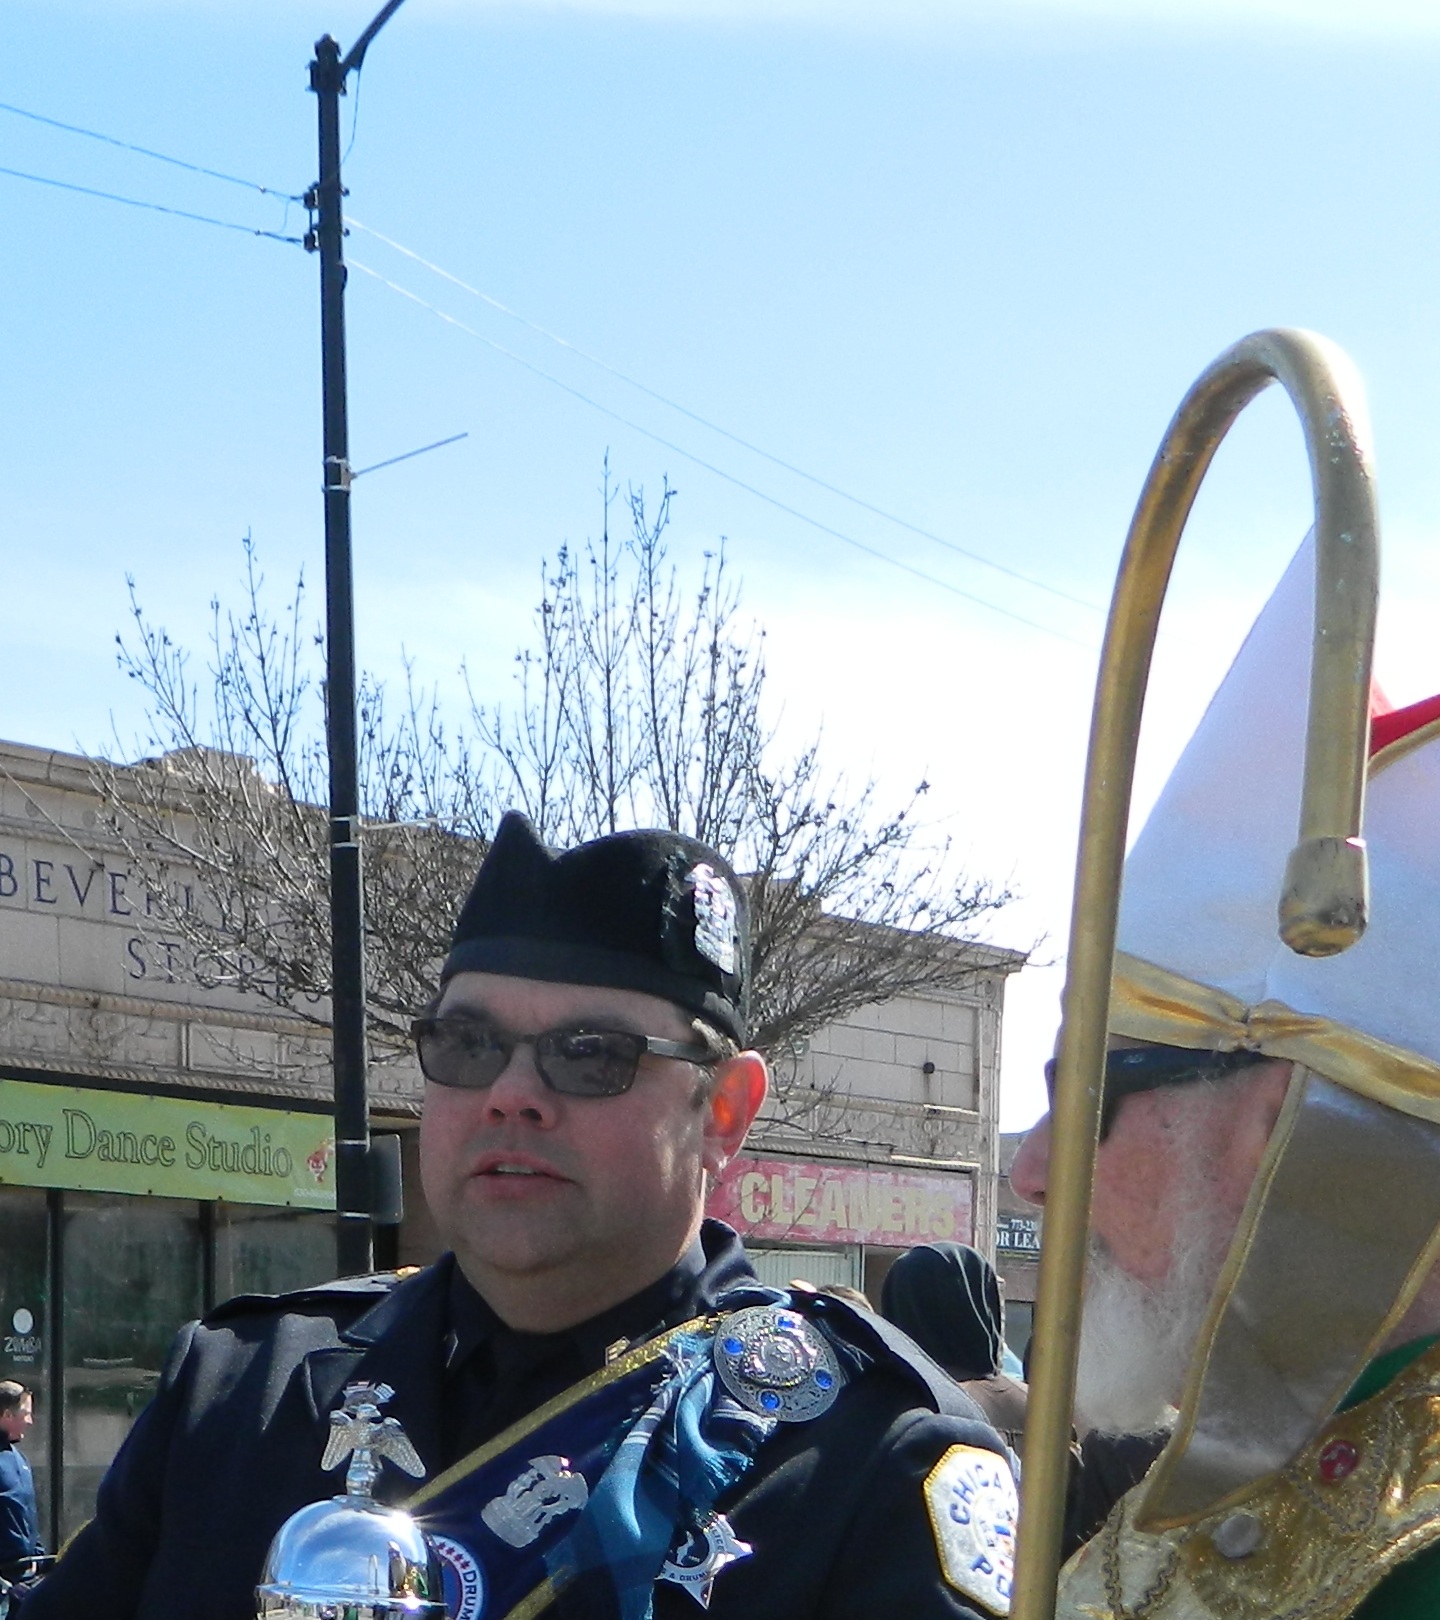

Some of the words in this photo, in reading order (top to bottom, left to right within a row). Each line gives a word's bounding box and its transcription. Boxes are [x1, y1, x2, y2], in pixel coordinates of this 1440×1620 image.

[63, 1108, 176, 1167] Dance
[185, 1120, 293, 1178] Studio
[740, 1171, 955, 1237] CLEANERS
